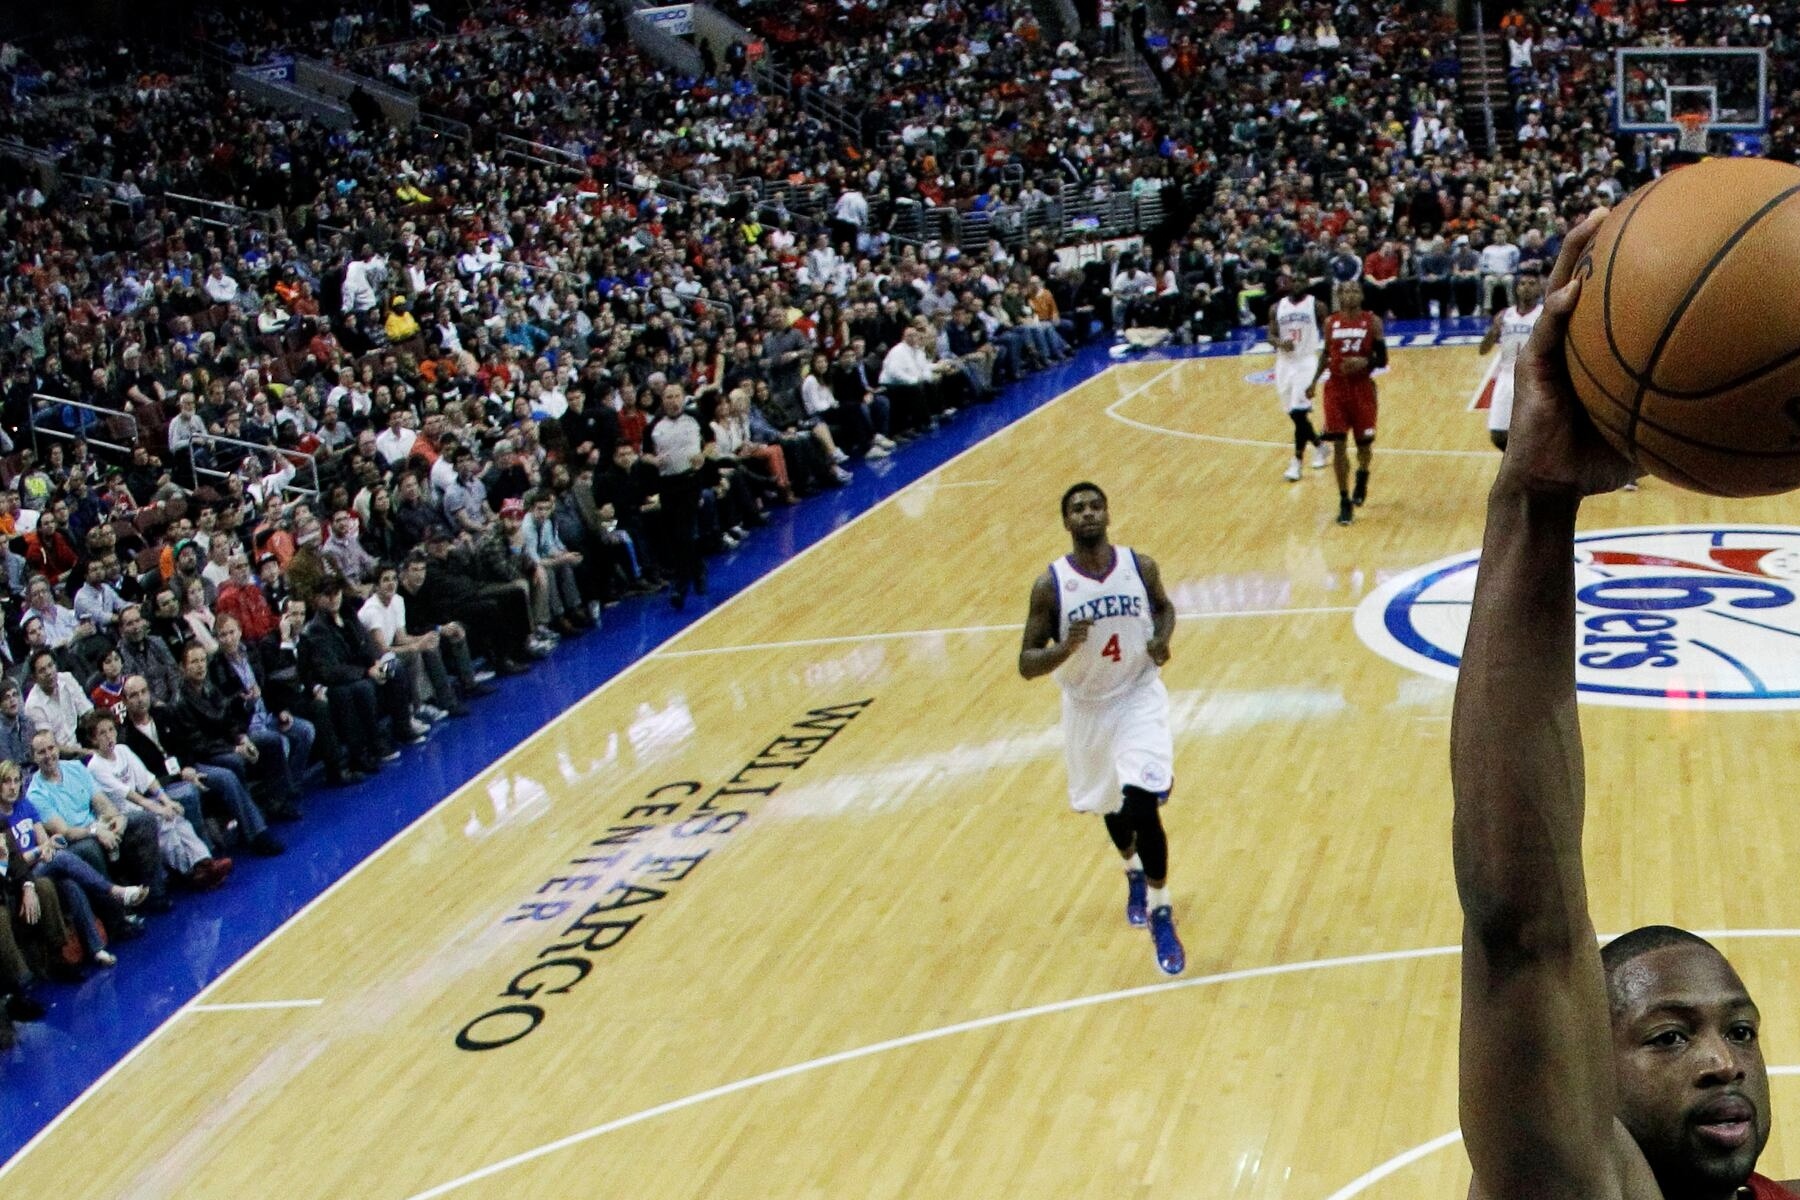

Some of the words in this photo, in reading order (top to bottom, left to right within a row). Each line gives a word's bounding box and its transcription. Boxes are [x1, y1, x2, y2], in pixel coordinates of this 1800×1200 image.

[1340, 338, 1363, 353] 34
[1102, 633, 1121, 662] 4
[671, 698, 875, 839] WELLS
[503, 780, 703, 924] CENTER
[455, 849, 711, 1051] FARGO
